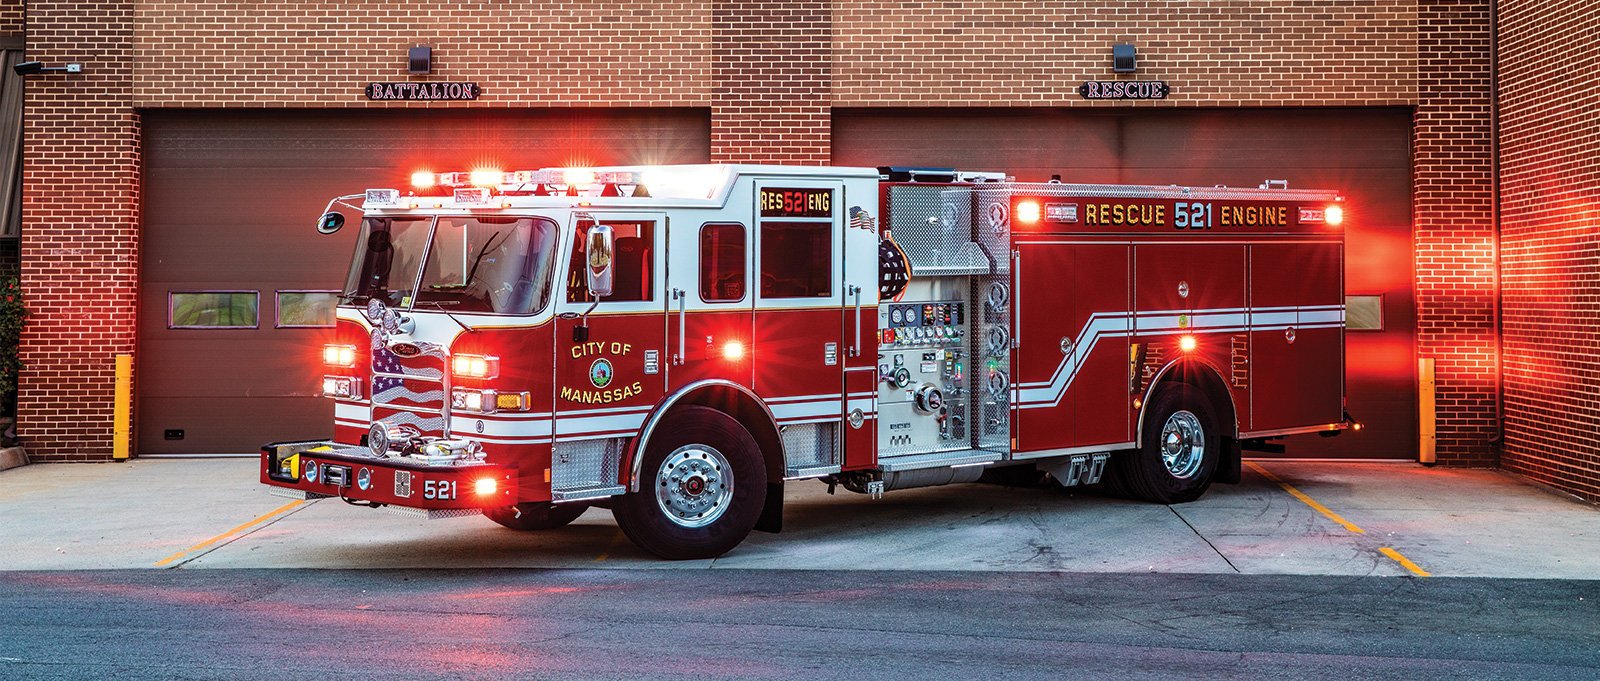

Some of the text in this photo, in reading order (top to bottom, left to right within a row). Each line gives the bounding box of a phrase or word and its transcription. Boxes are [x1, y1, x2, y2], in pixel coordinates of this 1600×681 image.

[371, 82, 473, 100] BATTALION
[1088, 81, 1163, 98] RESCUE
[1086, 202, 1287, 228] RESCUE 521 ENGINE
[571, 341, 632, 359] CITY OF
[560, 381, 643, 404] MANASSAS
[424, 480, 457, 500] 521
